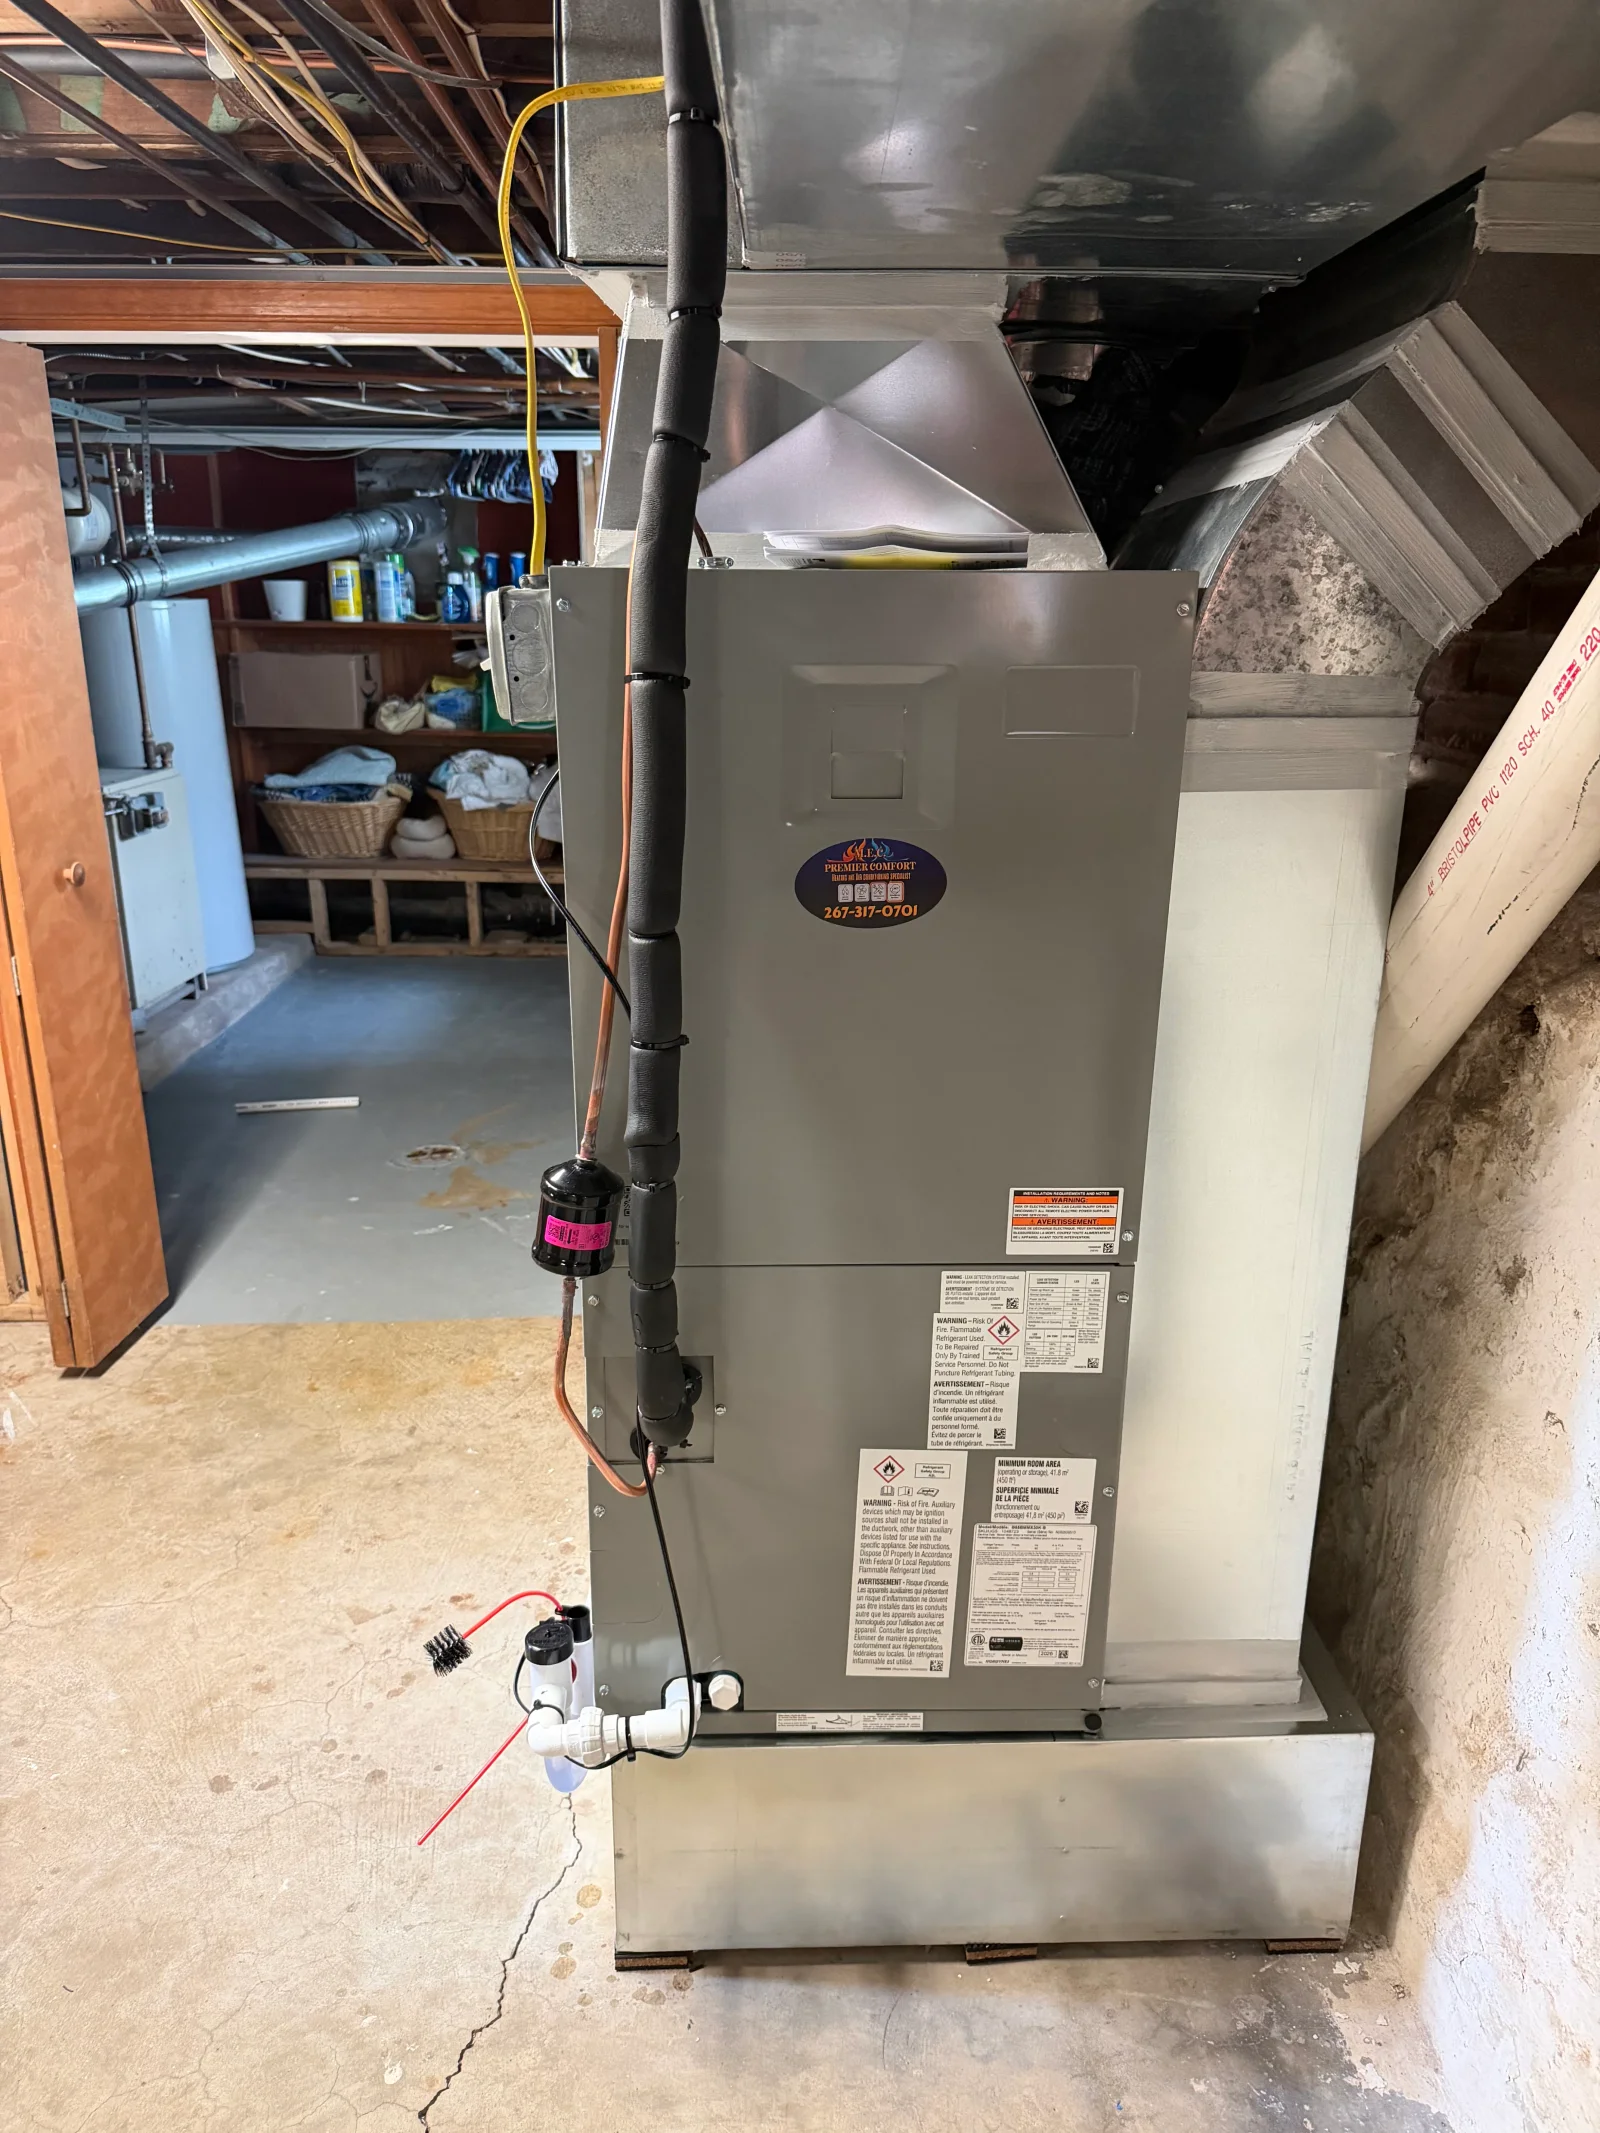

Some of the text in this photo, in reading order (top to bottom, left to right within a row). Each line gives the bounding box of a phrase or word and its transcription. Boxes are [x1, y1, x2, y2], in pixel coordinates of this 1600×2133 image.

[1437, 814, 1482, 881] BRISTOLPIPE
[1481, 785, 1500, 813] PVC
[1499, 757, 1519, 786] 1120
[1541, 699, 1555, 722] 40
[824, 861, 916, 873] PREMIER COMFORT
[824, 904, 918, 919] 267-317-0701
[997, 1469, 1021, 1477] (operating
[997, 1476, 1008, 1484] (450
[932, 1501, 955, 1509] Auxiliary
[924, 1509, 944, 1517] ignition
[994, 1512, 1024, 1520] entreposage)
[872, 1525, 898, 1533] ductwork,
[881, 1542, 907, 1550] appliance.
[891, 1550, 913, 1558] Properly
[890, 1567, 920, 1575] Refrigerant
